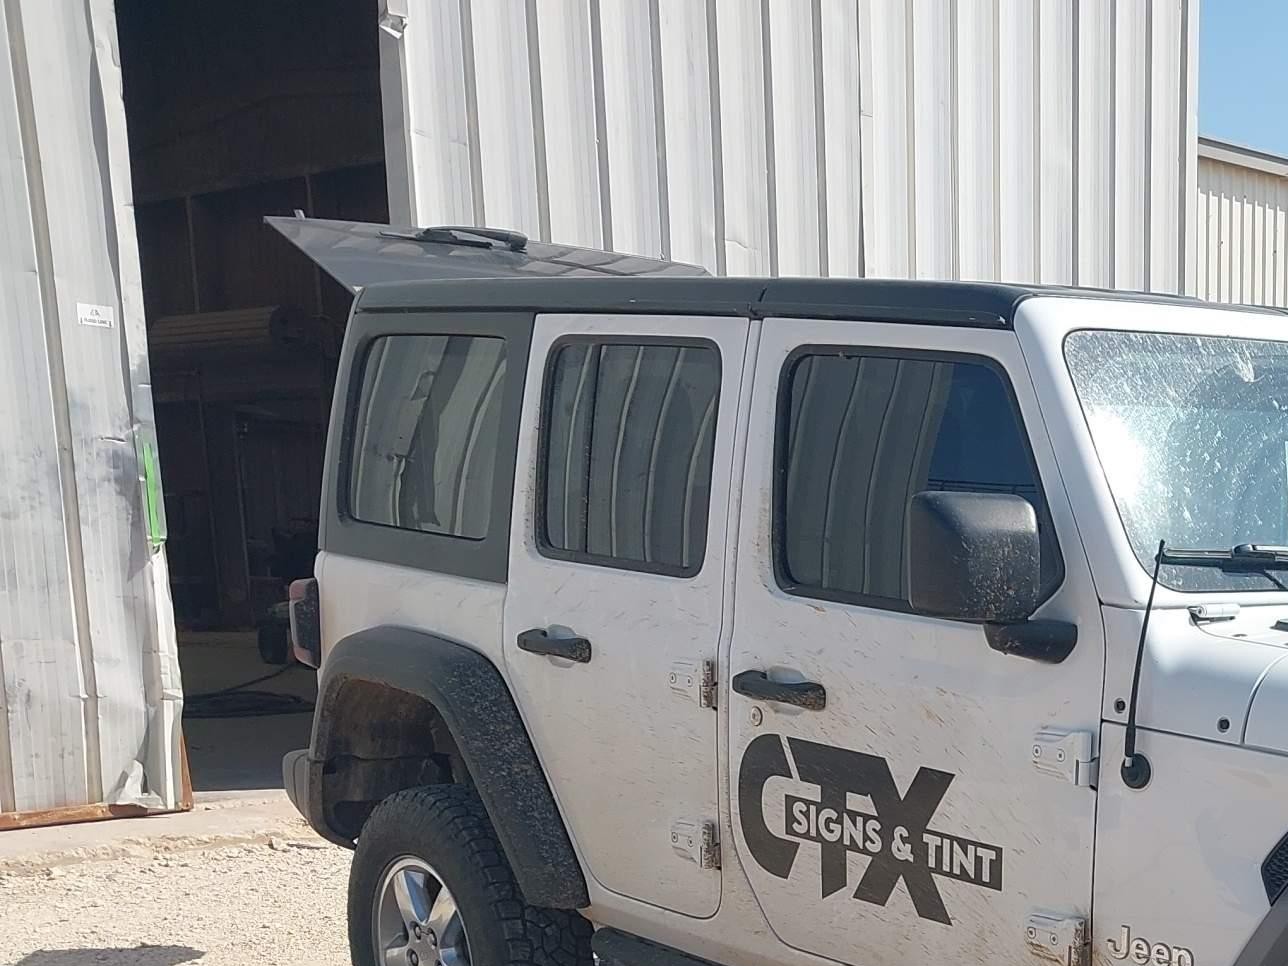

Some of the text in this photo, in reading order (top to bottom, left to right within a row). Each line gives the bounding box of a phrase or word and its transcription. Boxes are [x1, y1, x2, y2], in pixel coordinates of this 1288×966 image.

[792, 801, 997, 883] SIGNS & TINT
